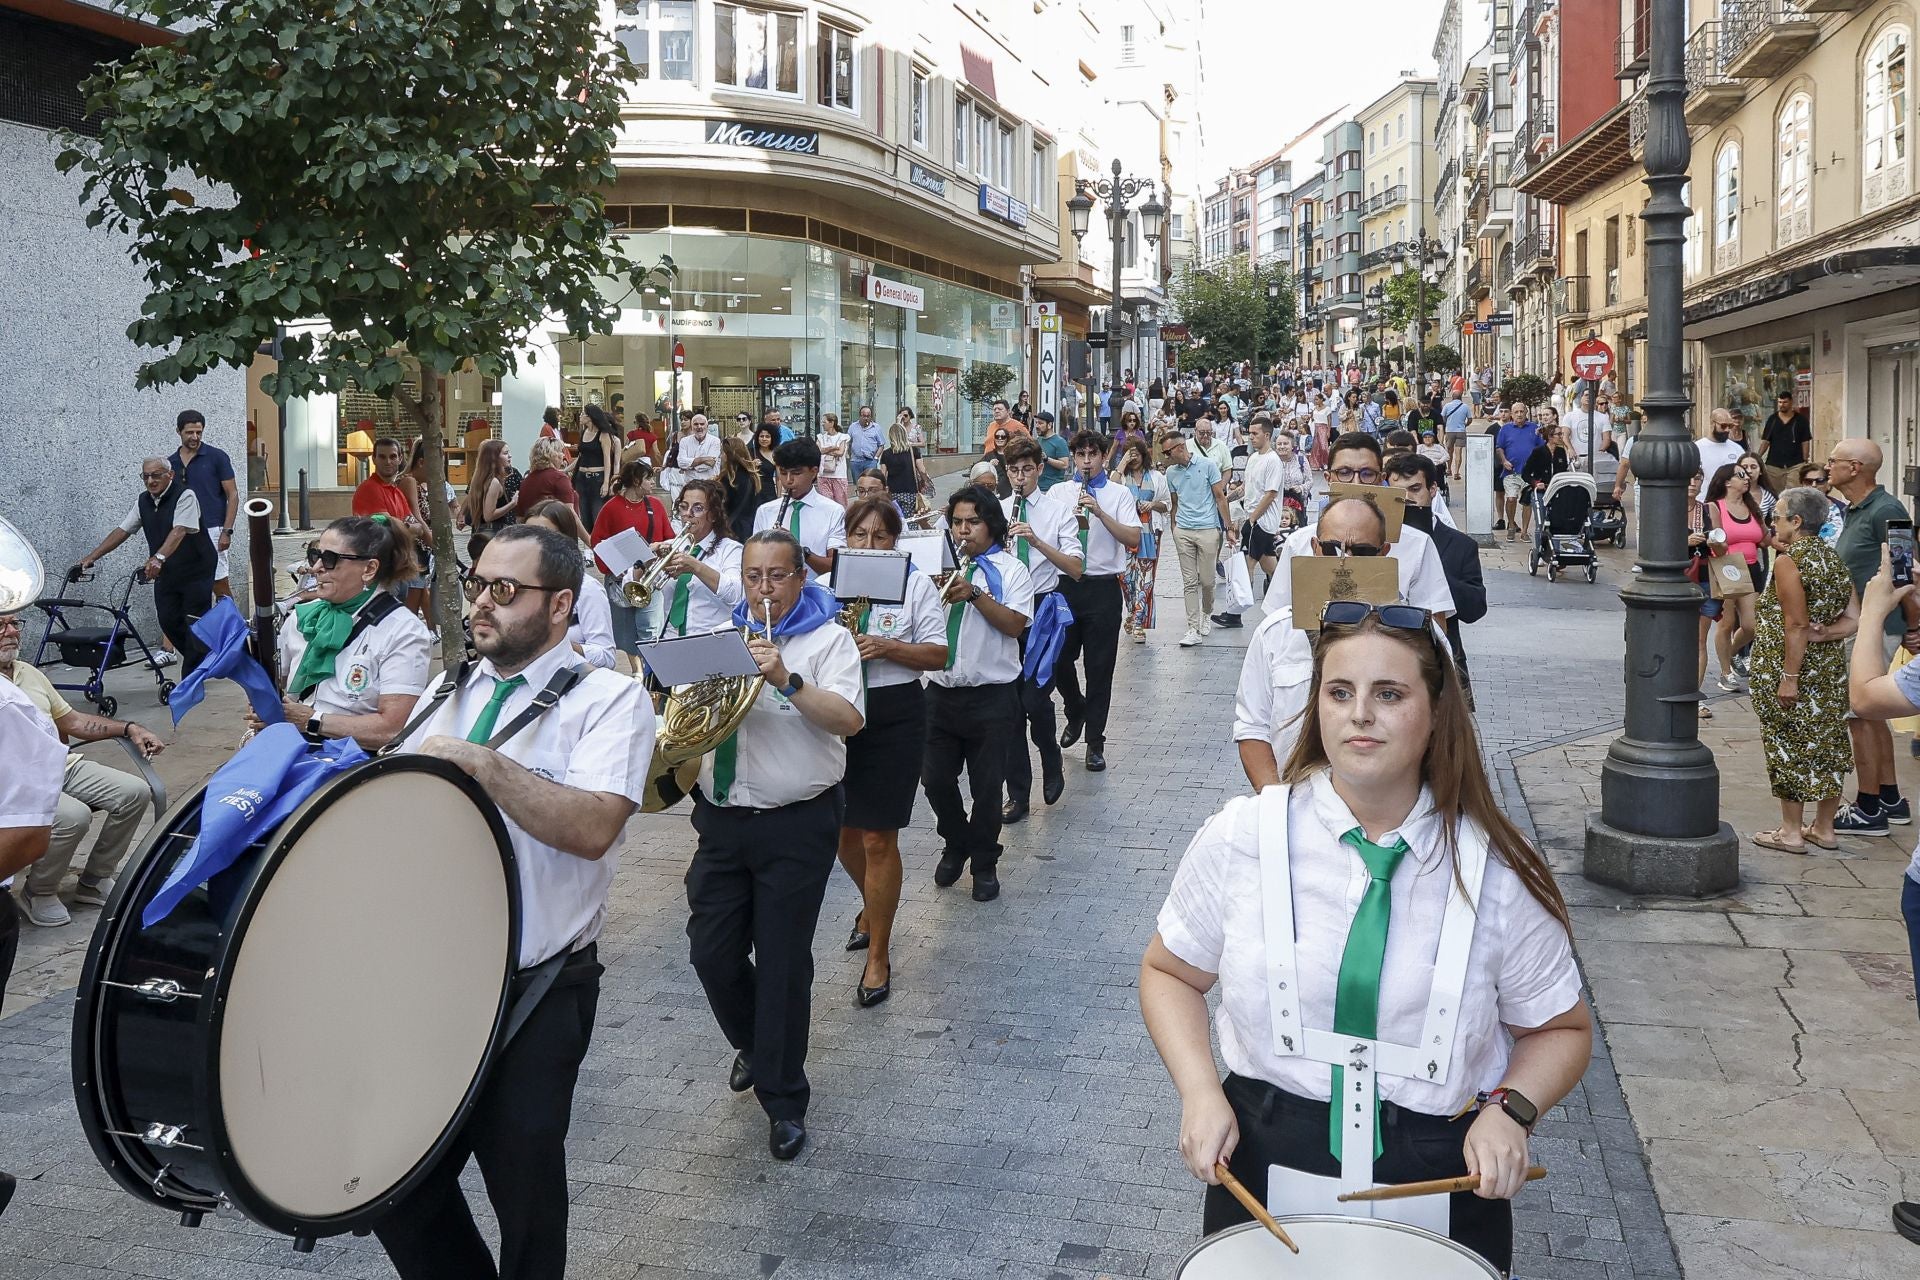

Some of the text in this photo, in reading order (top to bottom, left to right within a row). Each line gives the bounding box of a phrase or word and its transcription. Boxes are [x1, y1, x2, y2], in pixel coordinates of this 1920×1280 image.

[707, 122, 817, 153] Manuel
[883, 285, 902, 300] General
[1042, 350, 1054, 412] AVI
[231, 787, 263, 805] Avilés
